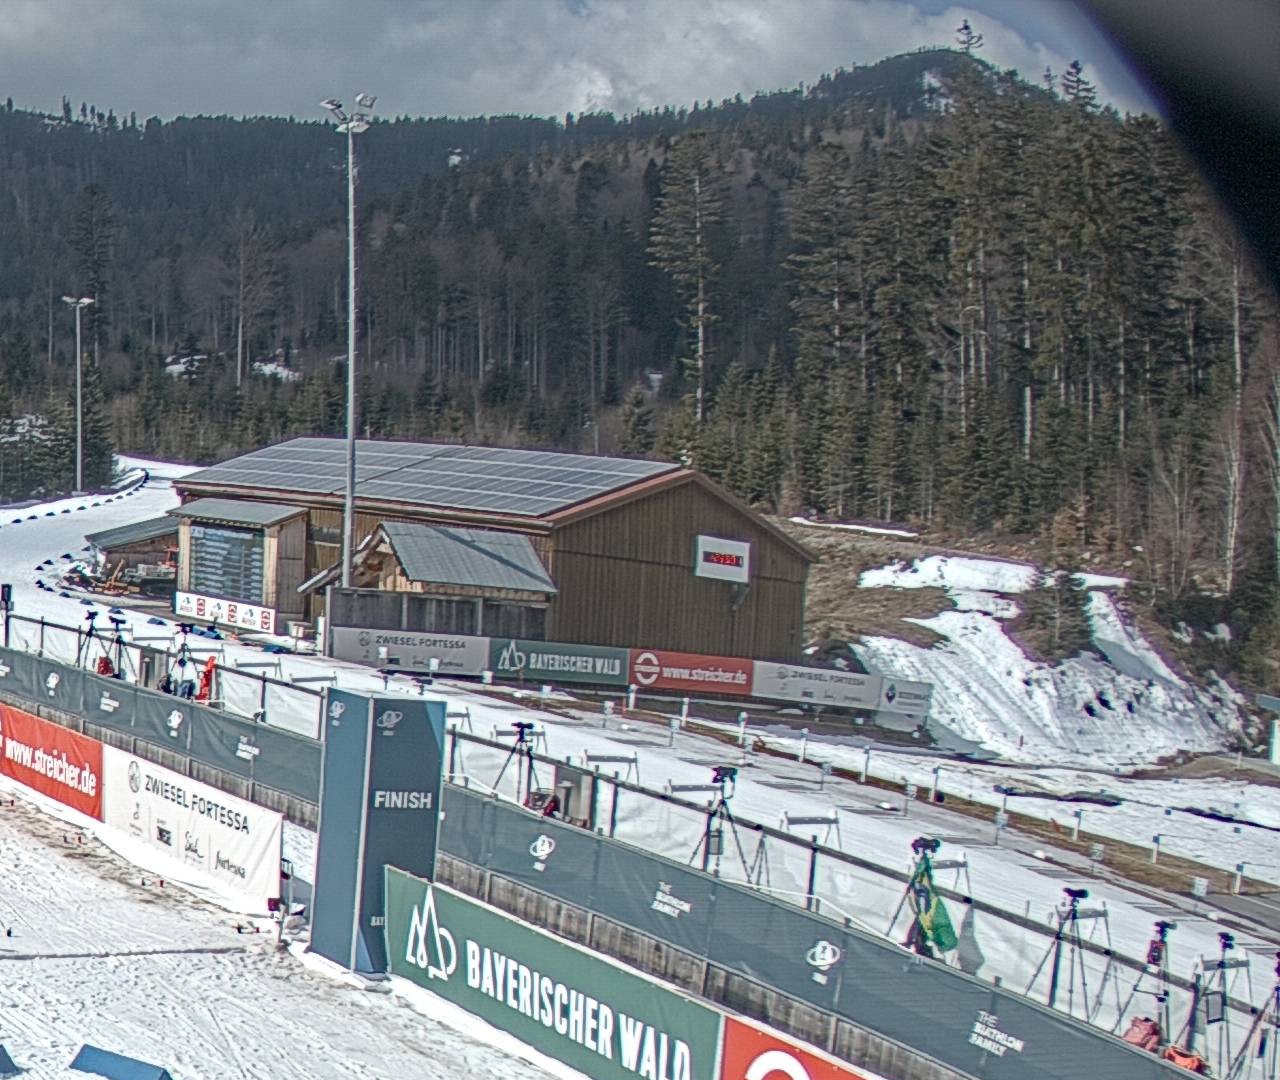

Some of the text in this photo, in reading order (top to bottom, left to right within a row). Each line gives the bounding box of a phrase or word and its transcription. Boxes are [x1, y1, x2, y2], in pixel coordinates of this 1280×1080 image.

[375, 635, 466, 649] ZWIESEL FORTESSA
[529, 652, 621, 675] BAYERISCHER WALD
[662, 666, 747, 685] www.streicher.de
[5, 737, 97, 797] www.streicher.de
[145, 774, 189, 808] ZWIESEL
[192, 794, 250, 835] FORTESSA
[374, 791, 432, 809] FINISH
[465, 939, 615, 1060] BAYERISCHER
